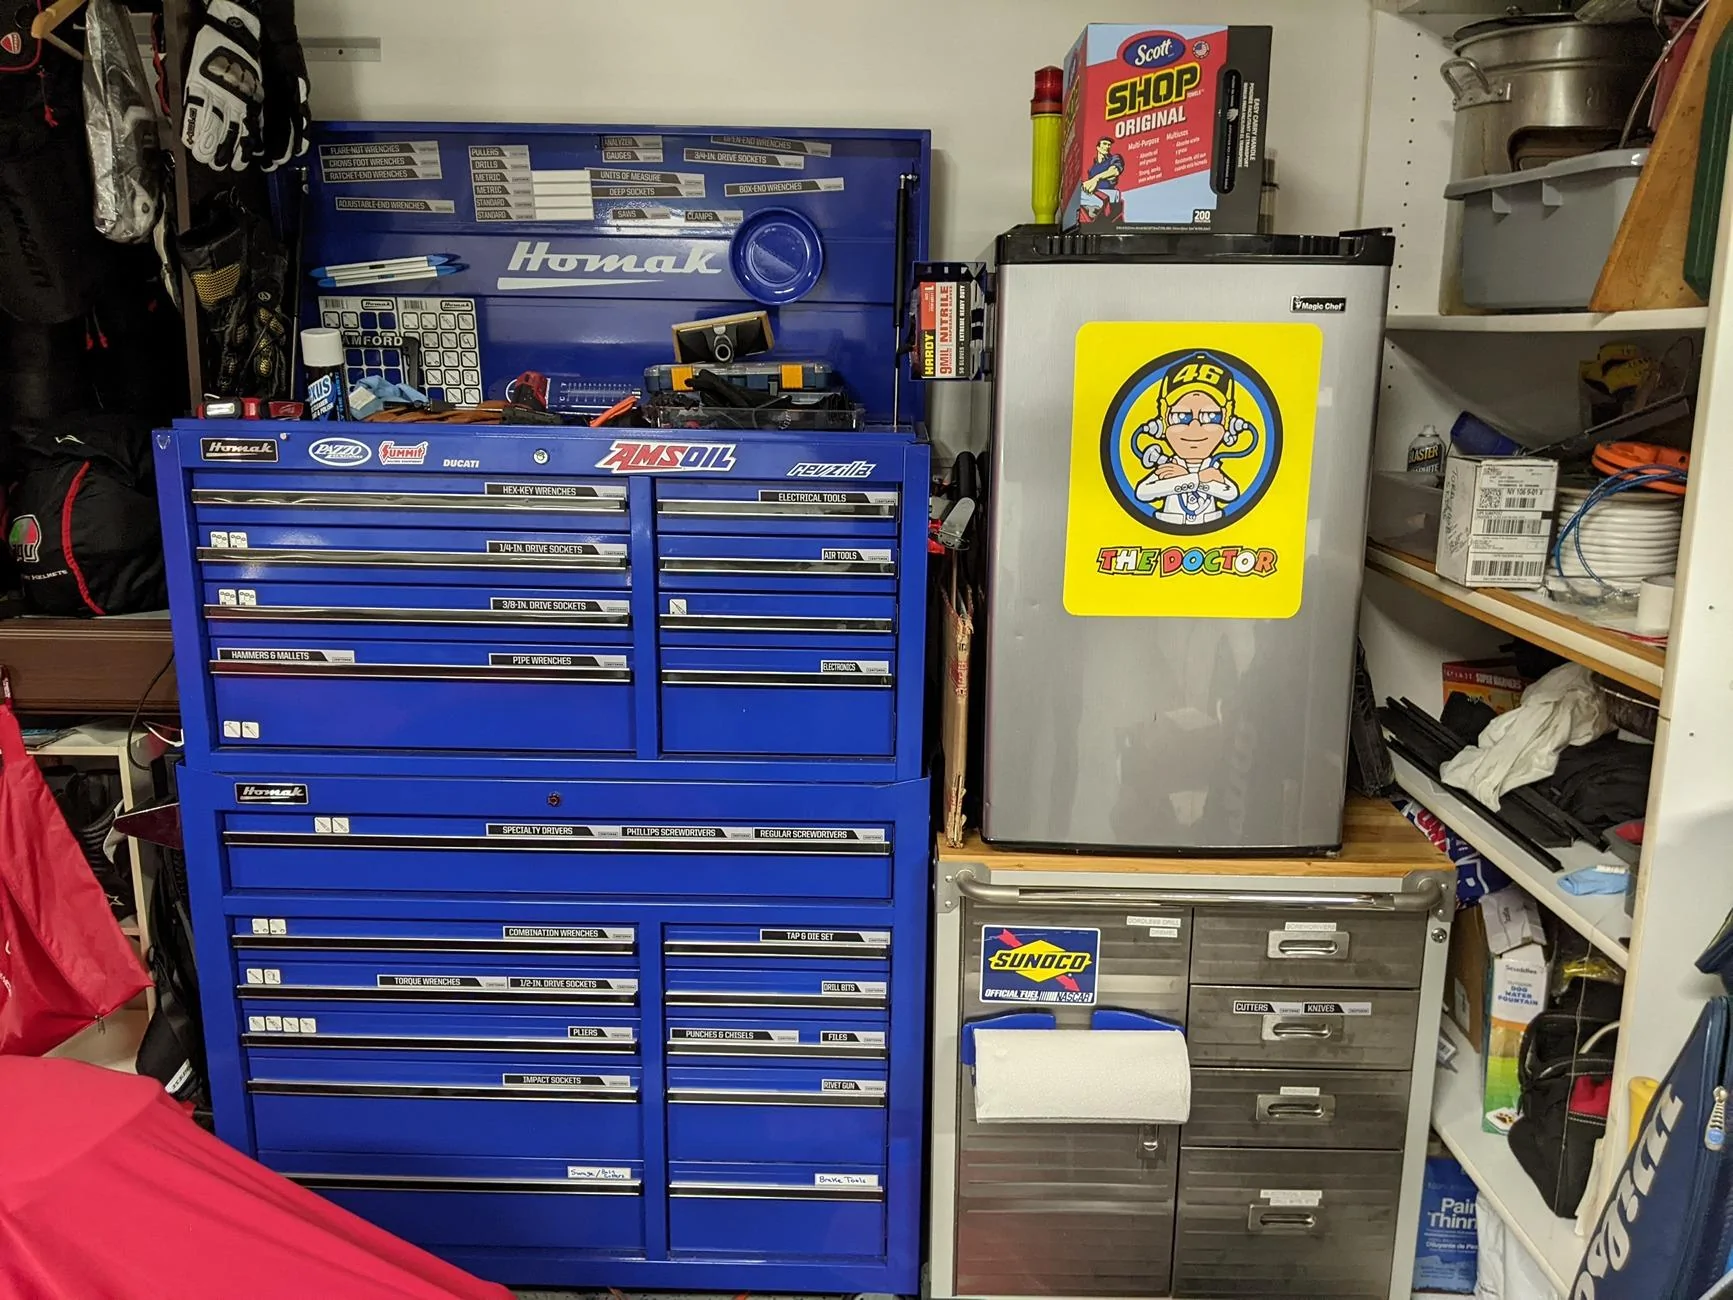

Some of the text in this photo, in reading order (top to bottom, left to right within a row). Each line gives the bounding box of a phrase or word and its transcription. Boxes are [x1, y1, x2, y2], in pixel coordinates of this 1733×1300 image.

[1134, 38, 1173, 66] Scott
[1106, 63, 1201, 119] SHOP
[1115, 106, 1186, 139] ORIGINAL
[330, 144, 400, 154] FLARE-NUT WRENCHES
[471, 147, 500, 157] PULLERS
[606, 151, 632, 160] GAUGES
[716, 152, 738, 162] DRIVE
[737, 154, 767, 164] SOCKETS
[329, 157, 405, 168] CROWS FOOT WRENCHES
[475, 160, 498, 169] DRILLS
[329, 169, 408, 180] RATCHET-END WRENCHES
[475, 173, 501, 182] METRIC
[600, 171, 662, 182] UNITS OF MEASURE
[476, 186, 502, 195] METRIC
[609, 188, 655, 197] DEEP SOCKETS
[739, 182, 802, 194] BOX-END WRENCHES
[338, 199, 425, 210] ADJUSTABLE-END WRENCHES
[476, 197, 506, 207] STANDARD
[477, 210, 507, 219] STANDARD
[617, 209, 637, 219] SAWS
[686, 211, 714, 221] CLAMPS
[1194, 211, 1211, 221] 200
[507, 241, 722, 275] Homak
[1302, 302, 1342, 311] Magic Chef
[940, 286, 949, 343] NITRILE
[925, 334, 935, 375] HARDY
[1172, 362, 1224, 385] 46
[308, 377, 330, 401] XUS
[209, 442, 273, 455] Homak
[314, 444, 362, 455] PAZZO
[381, 442, 425, 459] SUMMIT
[600, 443, 734, 472] AMSOIL
[443, 459, 480, 468] DUCATI
[788, 461, 875, 476] revzilla
[502, 486, 577, 496] HEX-KEY WRENCHES
[778, 493, 847, 503] ELECTRICAL TOOLS
[500, 544, 583, 554] 1/4-IN. DRIVE SOCKETS
[824, 551, 857, 560] AIR TOOLS
[1098, 546, 1277, 577] THE DOCTOR
[32, 570, 68, 580] HELMETS
[502, 600, 587, 611] 3/8-IN. DRIVE SOCKETS
[231, 651, 310, 660] HAMMERS & MALLETS
[512, 655, 572, 666] PIPE WRENCHES
[823, 662, 857, 672] ELECTRONICS
[243, 786, 304, 797] Homak
[503, 826, 573, 836] SPECIALTY DRIVERS
[626, 827, 659, 836] PHILLIPS
[660, 828, 716, 838] SCREWDRIVERS
[760, 829, 791, 838] REGULAR
[792, 830, 847, 839] SCREWDRIVERS
[509, 928, 599, 938] COMBINATION WRENCHES
[787, 932, 834, 941] TAP & DIE SET
[994, 952, 1087, 970] SUNOCO
[394, 977, 461, 986] TORQUE WRENCHES
[519, 979, 597, 989] 1/2-IN. DRIVE SOCKETS
[824, 983, 855, 992] DRILL BITS
[1510, 985, 1528, 993] DOG
[985, 989, 1019, 998] OFFICIAL
[1019, 989, 1039, 1000] FUEL
[1505, 991, 1532, 999] WATER
[1498, 995, 1538, 1006] FOUNTAIN
[1236, 1003, 1268, 1012] CUTTERS
[1307, 1004, 1335, 1013] KNIVES
[573, 1028, 598, 1037] PLIERS
[685, 1031, 754, 1040] PUNCHES & CHISELS
[828, 1033, 848, 1041] FILES
[523, 1076, 581, 1085] IMPACT SOCKETS
[824, 1081, 855, 1090] RIVET GUN
[818, 1175, 867, 1184] Brake Tools
